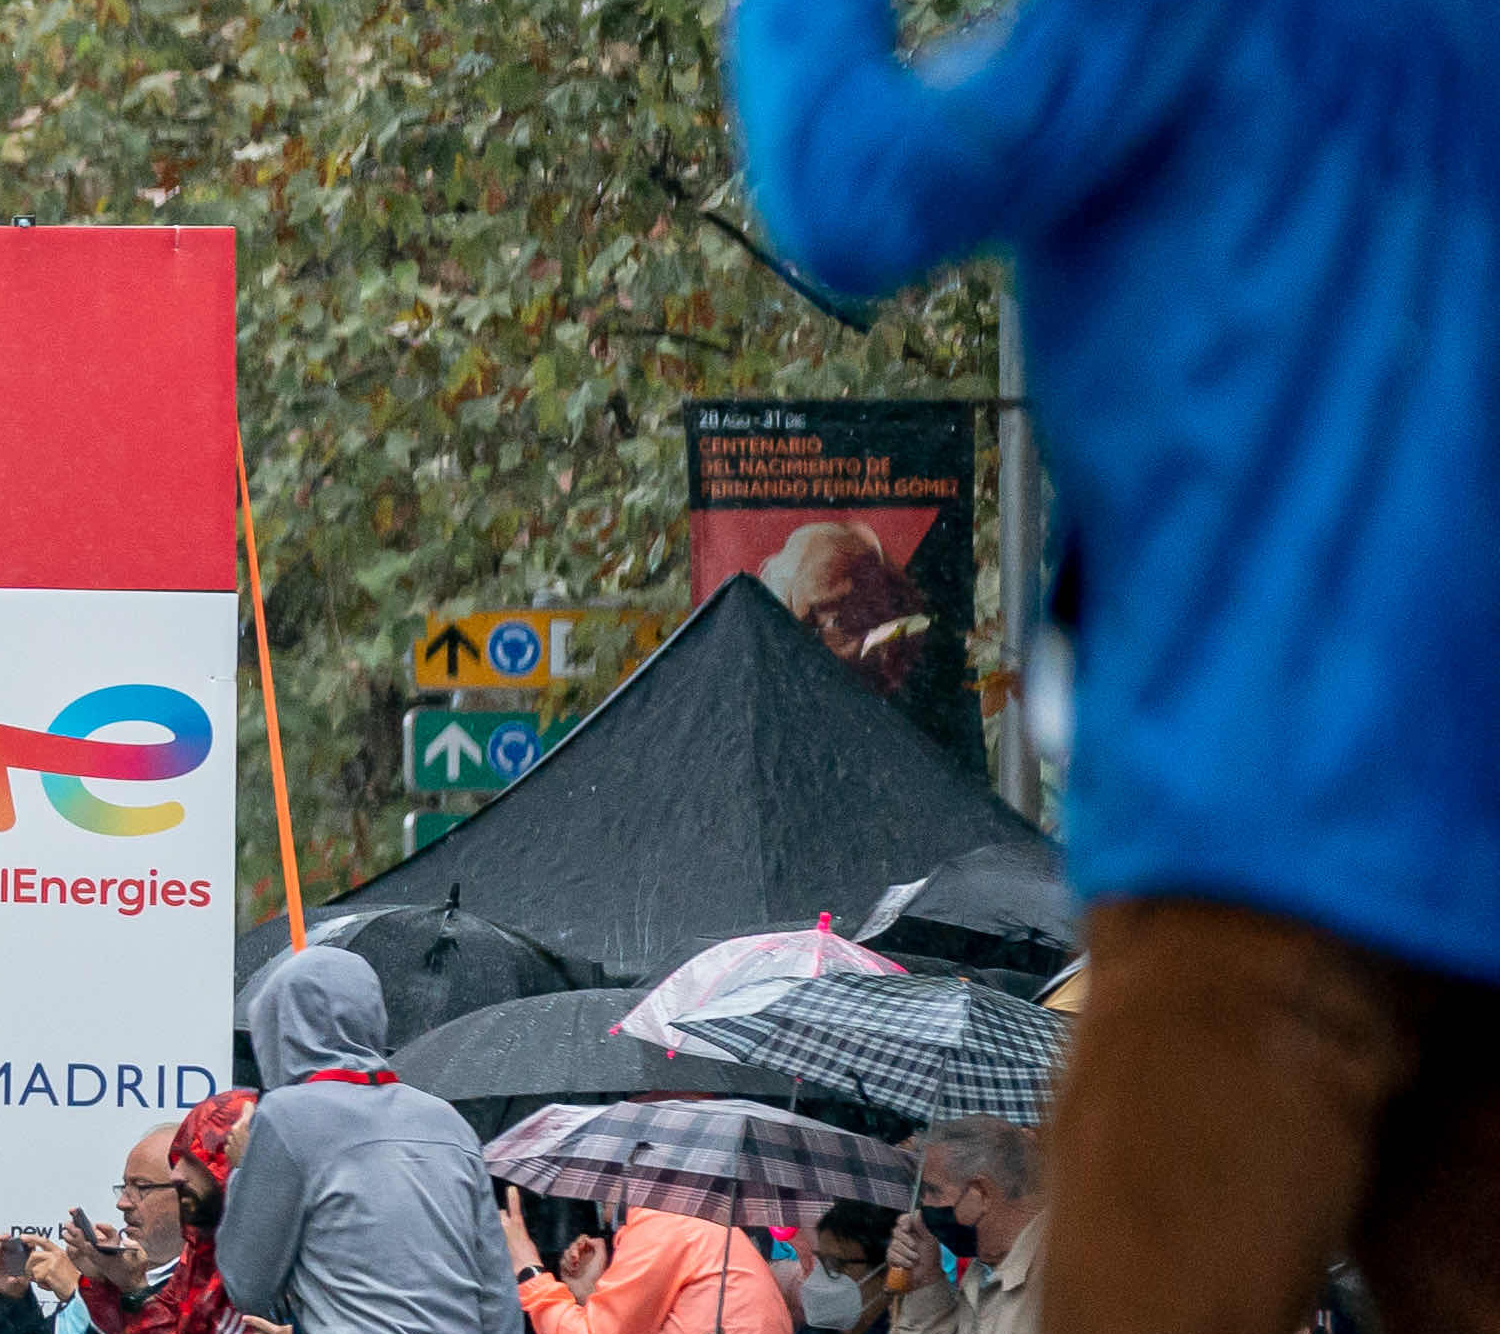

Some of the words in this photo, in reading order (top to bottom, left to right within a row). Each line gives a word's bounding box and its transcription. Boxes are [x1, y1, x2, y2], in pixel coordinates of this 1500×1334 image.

[699, 436, 823, 455] CENTENARIO
[700, 458, 733, 476] DEL
[739, 456, 861, 477] NACIMIENTO
[866, 456, 891, 476] DE
[700, 479, 808, 499] FERNANDO
